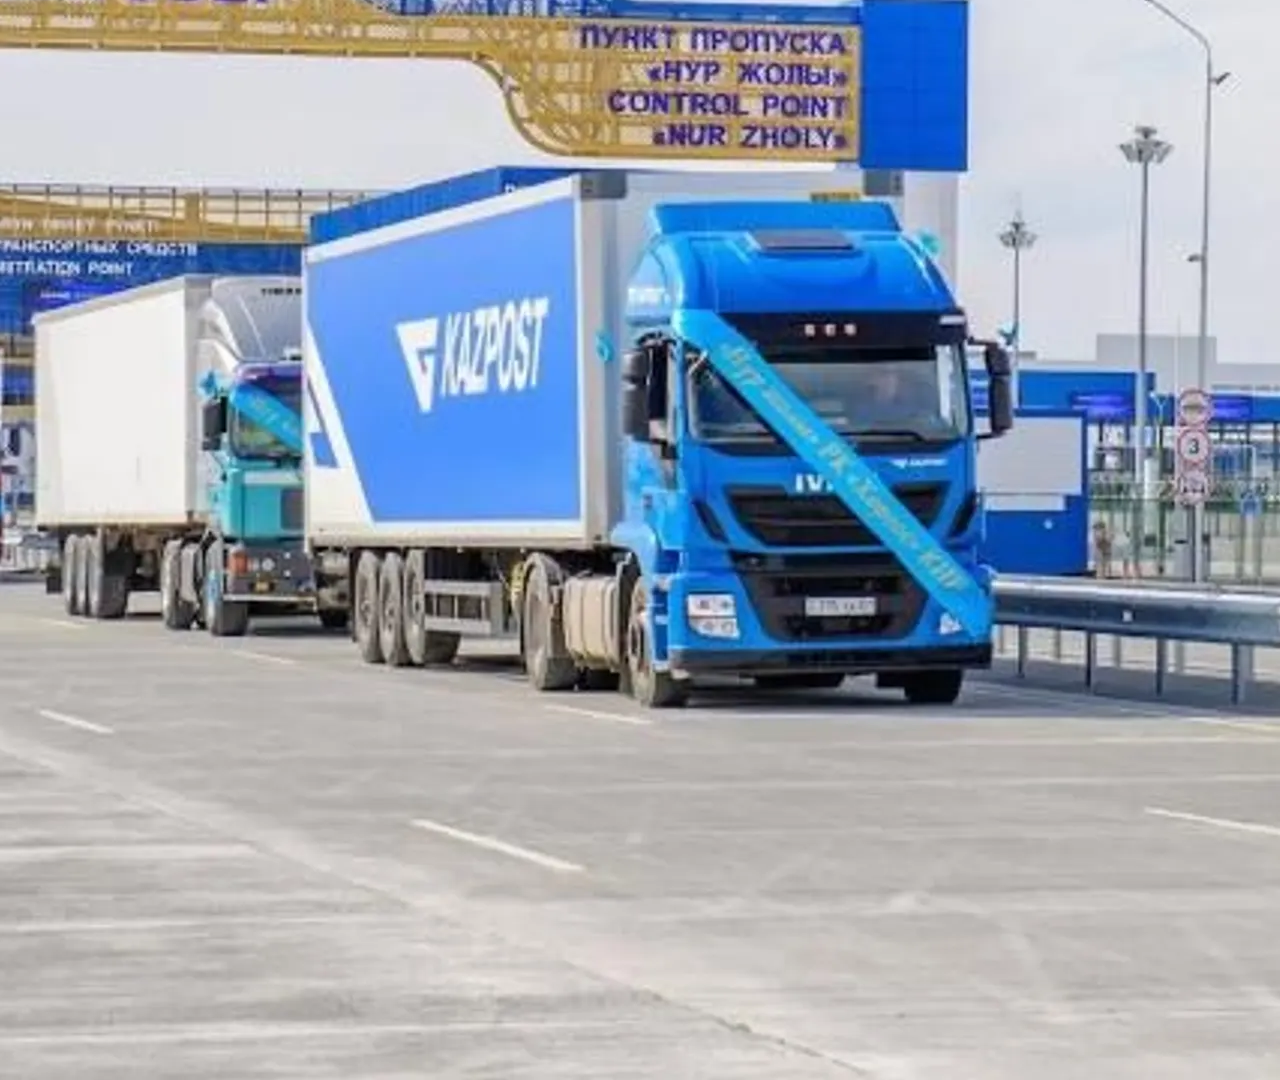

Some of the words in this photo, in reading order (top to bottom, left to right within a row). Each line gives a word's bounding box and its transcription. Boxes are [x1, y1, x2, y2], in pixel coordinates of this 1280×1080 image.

[580, 24, 677, 49] ПУНКТ
[690, 28, 846, 54] ПРОПУСКА
[608, 91, 748, 115] CONTROL
[762, 94, 849, 118] POINT
[87, 262, 134, 275] POINT
[439, 296, 549, 398] KAZPOST
[1188, 439, 1200, 454] 3
